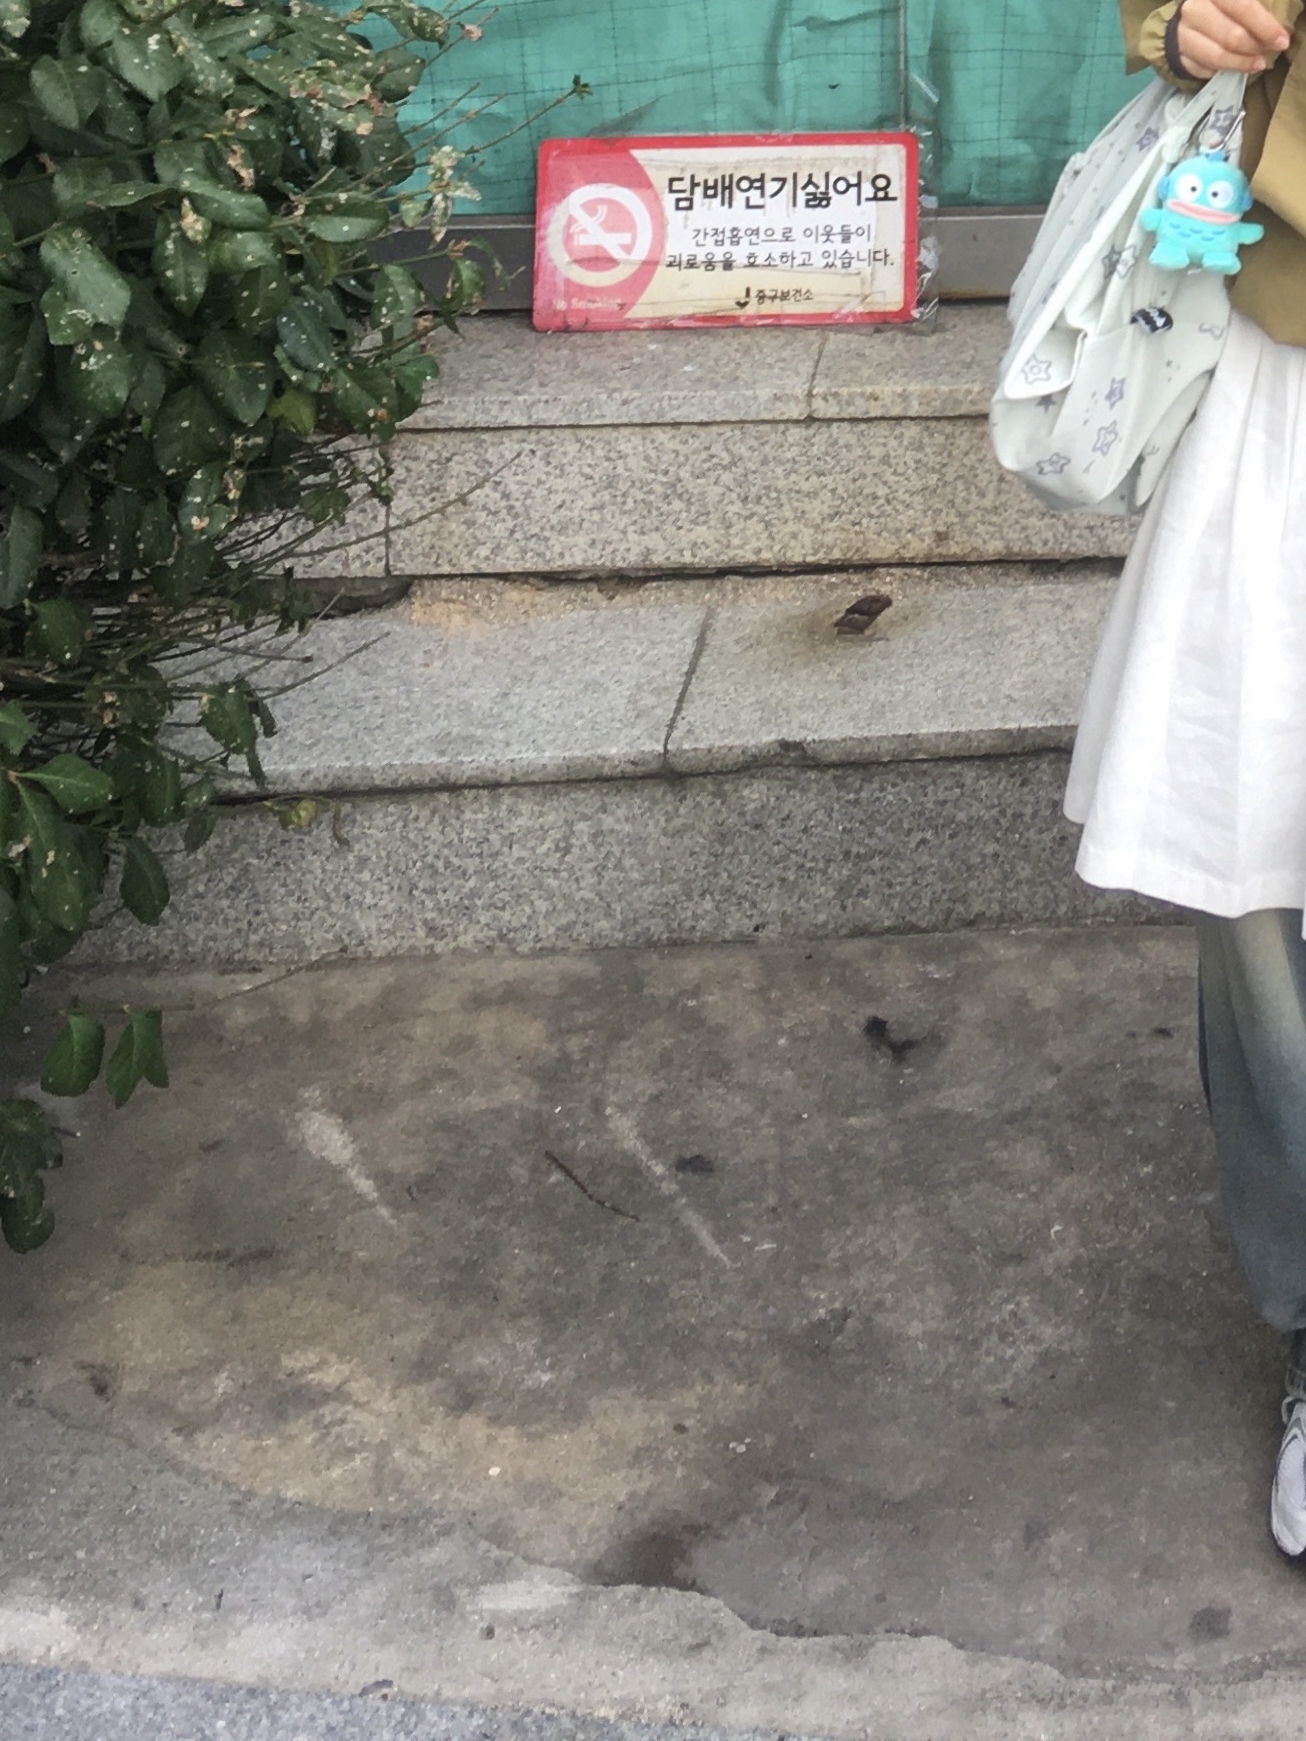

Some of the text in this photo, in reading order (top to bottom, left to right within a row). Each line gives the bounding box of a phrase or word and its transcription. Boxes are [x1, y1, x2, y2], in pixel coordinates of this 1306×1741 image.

[667, 171, 898, 211] 담배연기싫어요
[691, 224, 871, 247] 간접흡연으로 이웃들이
[665, 248, 894, 272] 괴로움을 호소하고 있습니다.
[755, 288, 814, 305] 중구보건소
